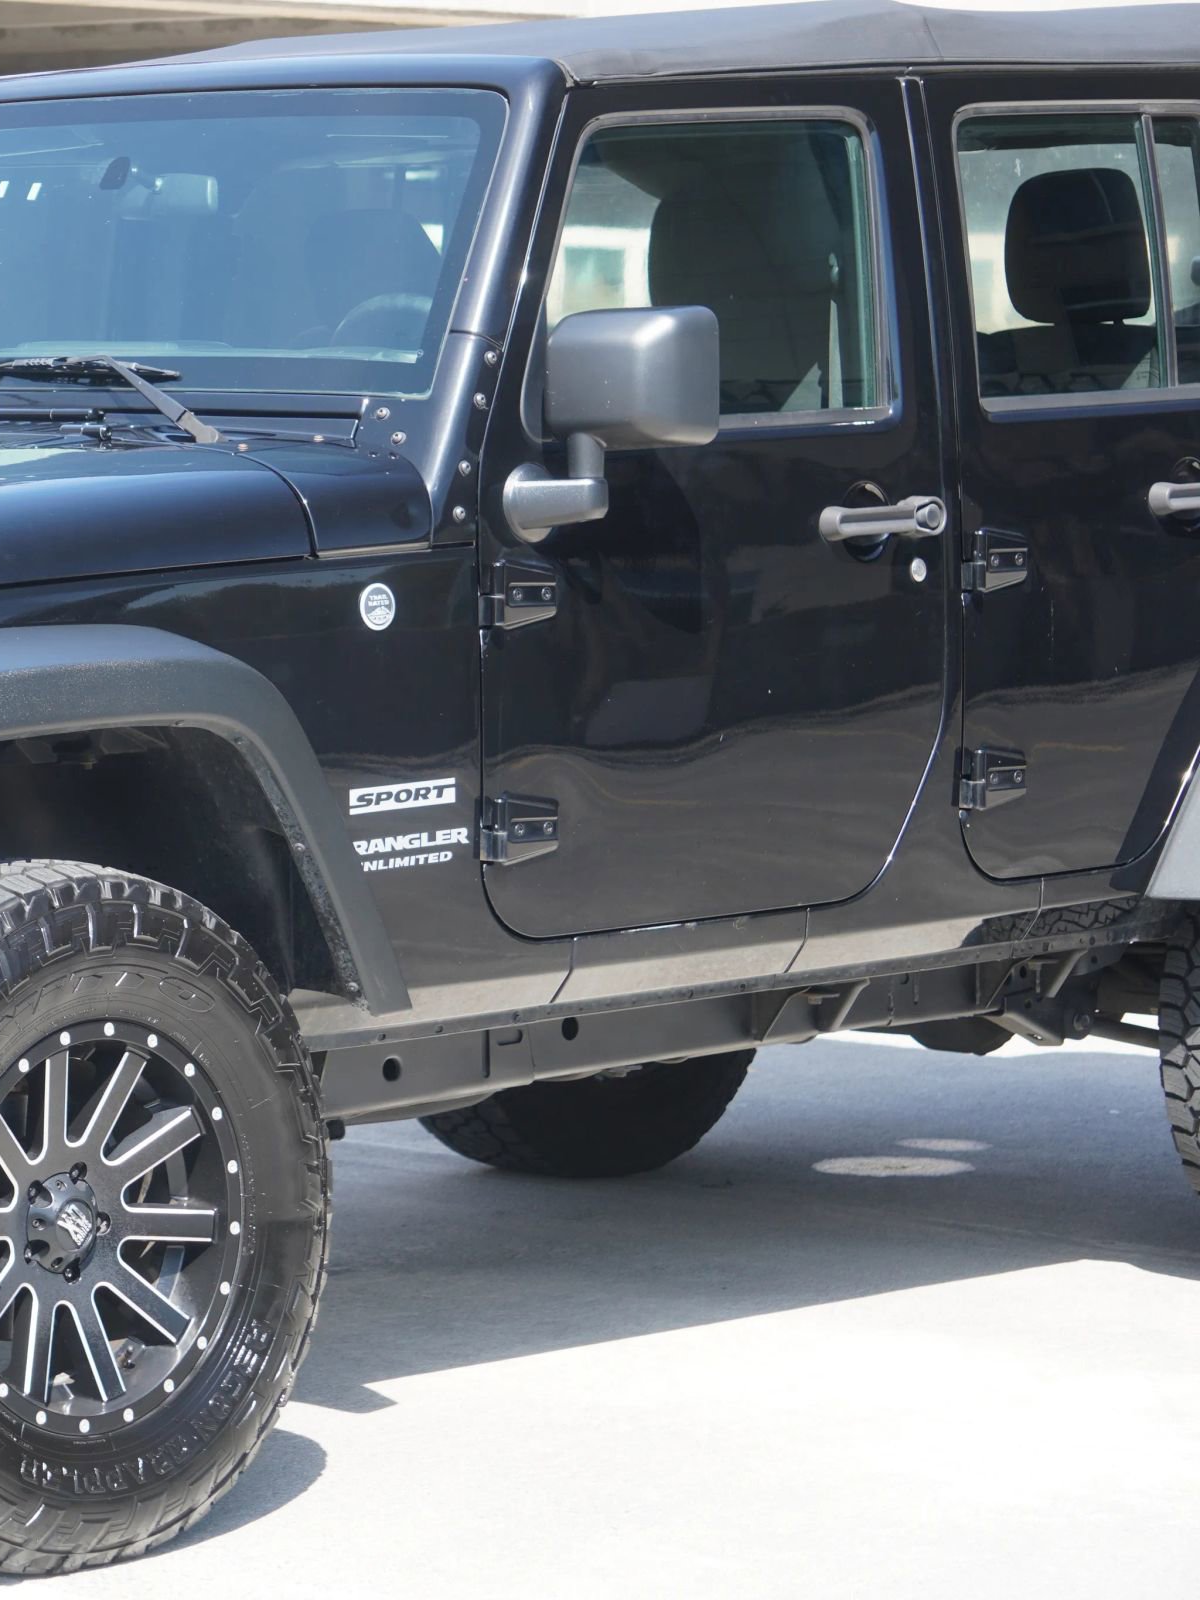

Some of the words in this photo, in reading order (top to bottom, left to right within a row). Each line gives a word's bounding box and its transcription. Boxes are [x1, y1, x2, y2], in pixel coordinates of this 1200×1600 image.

[351, 783, 455, 809] SPORT
[352, 827, 470, 855] RANGLER
[361, 851, 453, 872] NLIMITED
